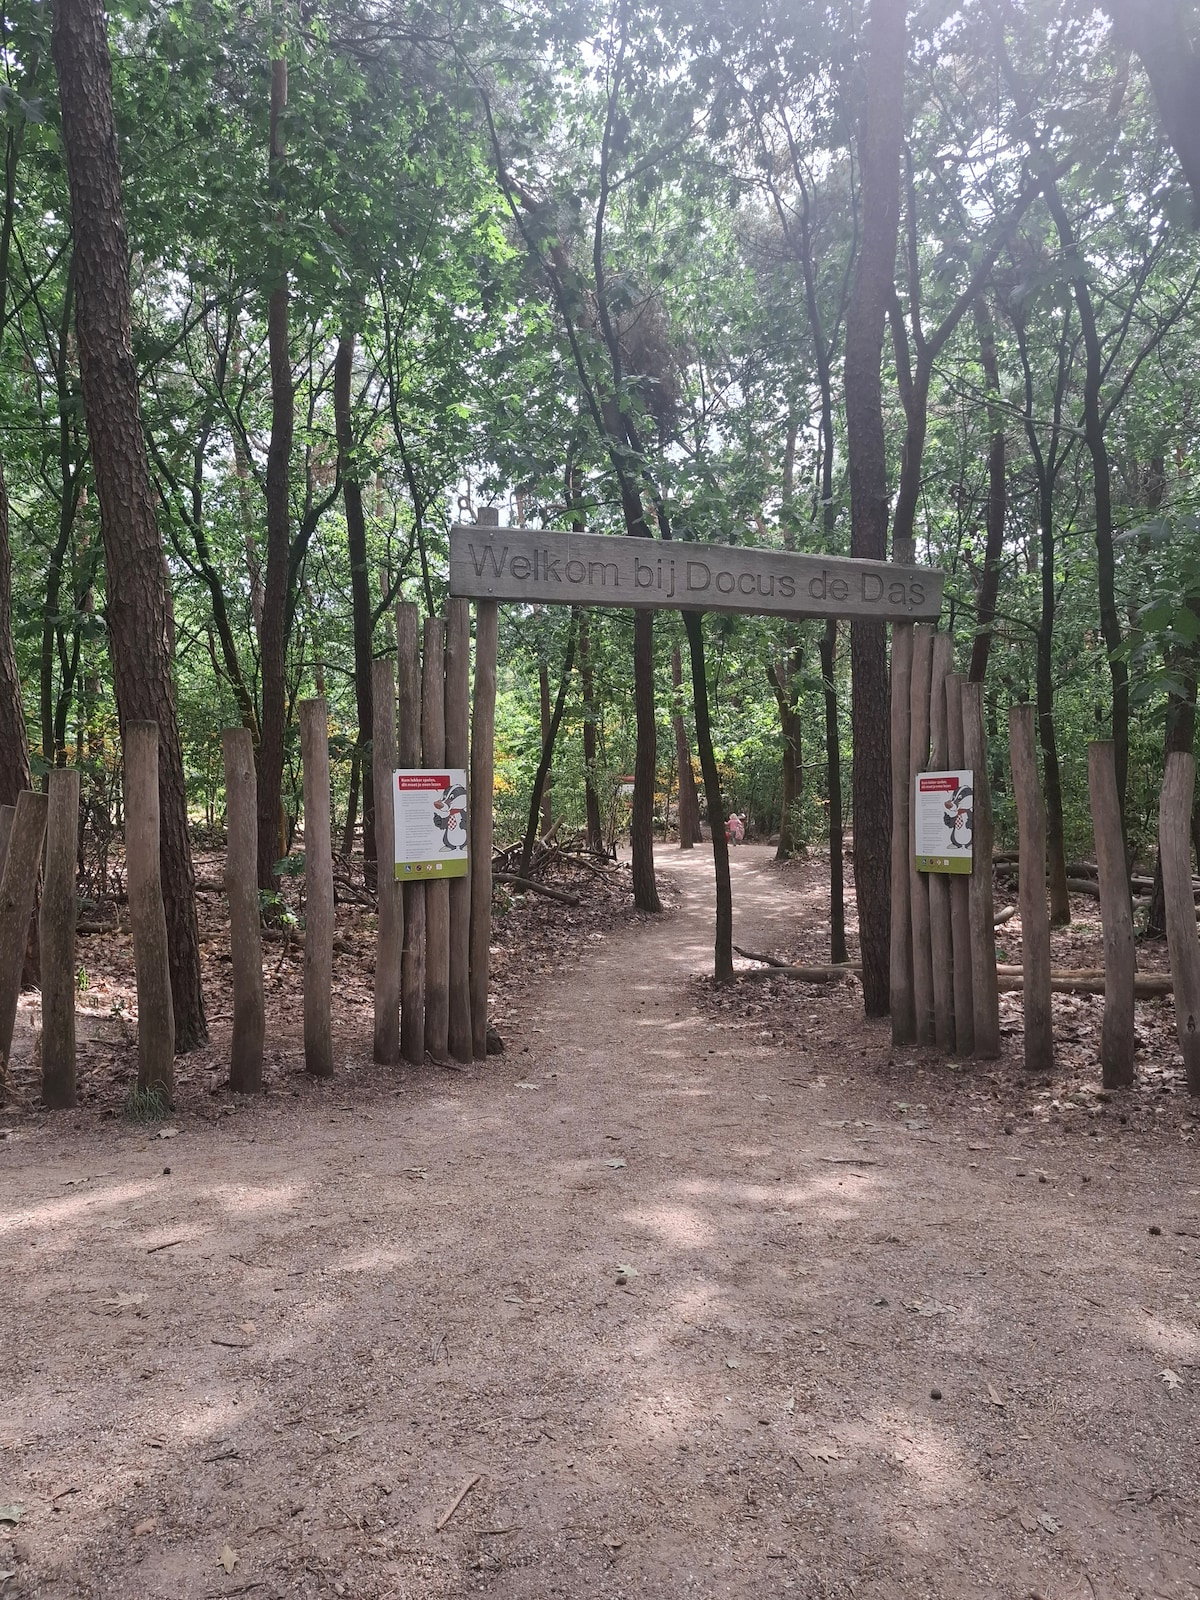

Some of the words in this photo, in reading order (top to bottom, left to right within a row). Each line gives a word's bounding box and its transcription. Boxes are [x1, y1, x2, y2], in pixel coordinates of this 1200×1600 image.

[468, 543, 619, 586] Welkom
[634, 557, 675, 598] bij
[686, 561, 796, 597] Docus
[808, 570, 849, 600] de
[861, 572, 926, 605] Das
